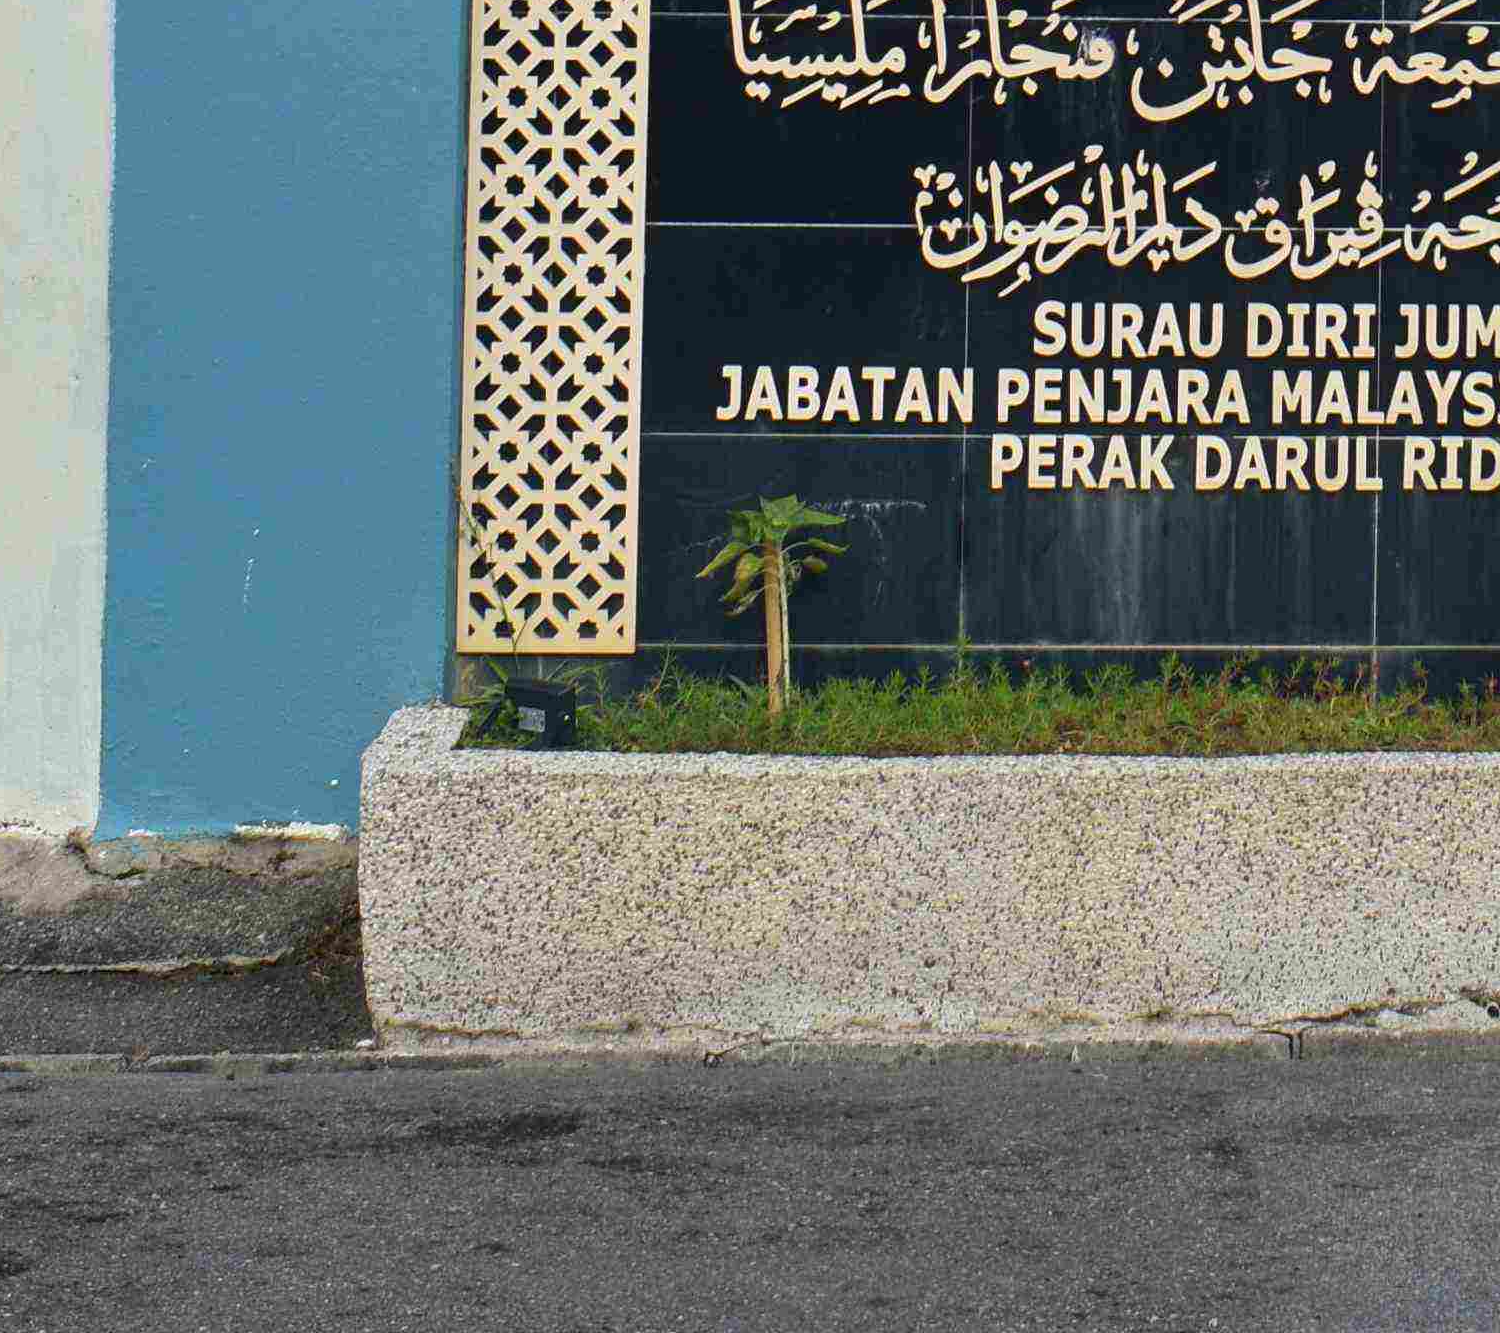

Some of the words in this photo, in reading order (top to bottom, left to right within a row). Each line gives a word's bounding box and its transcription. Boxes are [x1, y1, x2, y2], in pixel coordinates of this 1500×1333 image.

[1033, 299, 1224, 358] SURAU
[1246, 302, 1377, 359] DIRI
[716, 364, 974, 423] JABATAN
[997, 367, 1251, 424] PENJARA
[991, 434, 1175, 491] PERAK
[1195, 436, 1384, 491] DARUL
